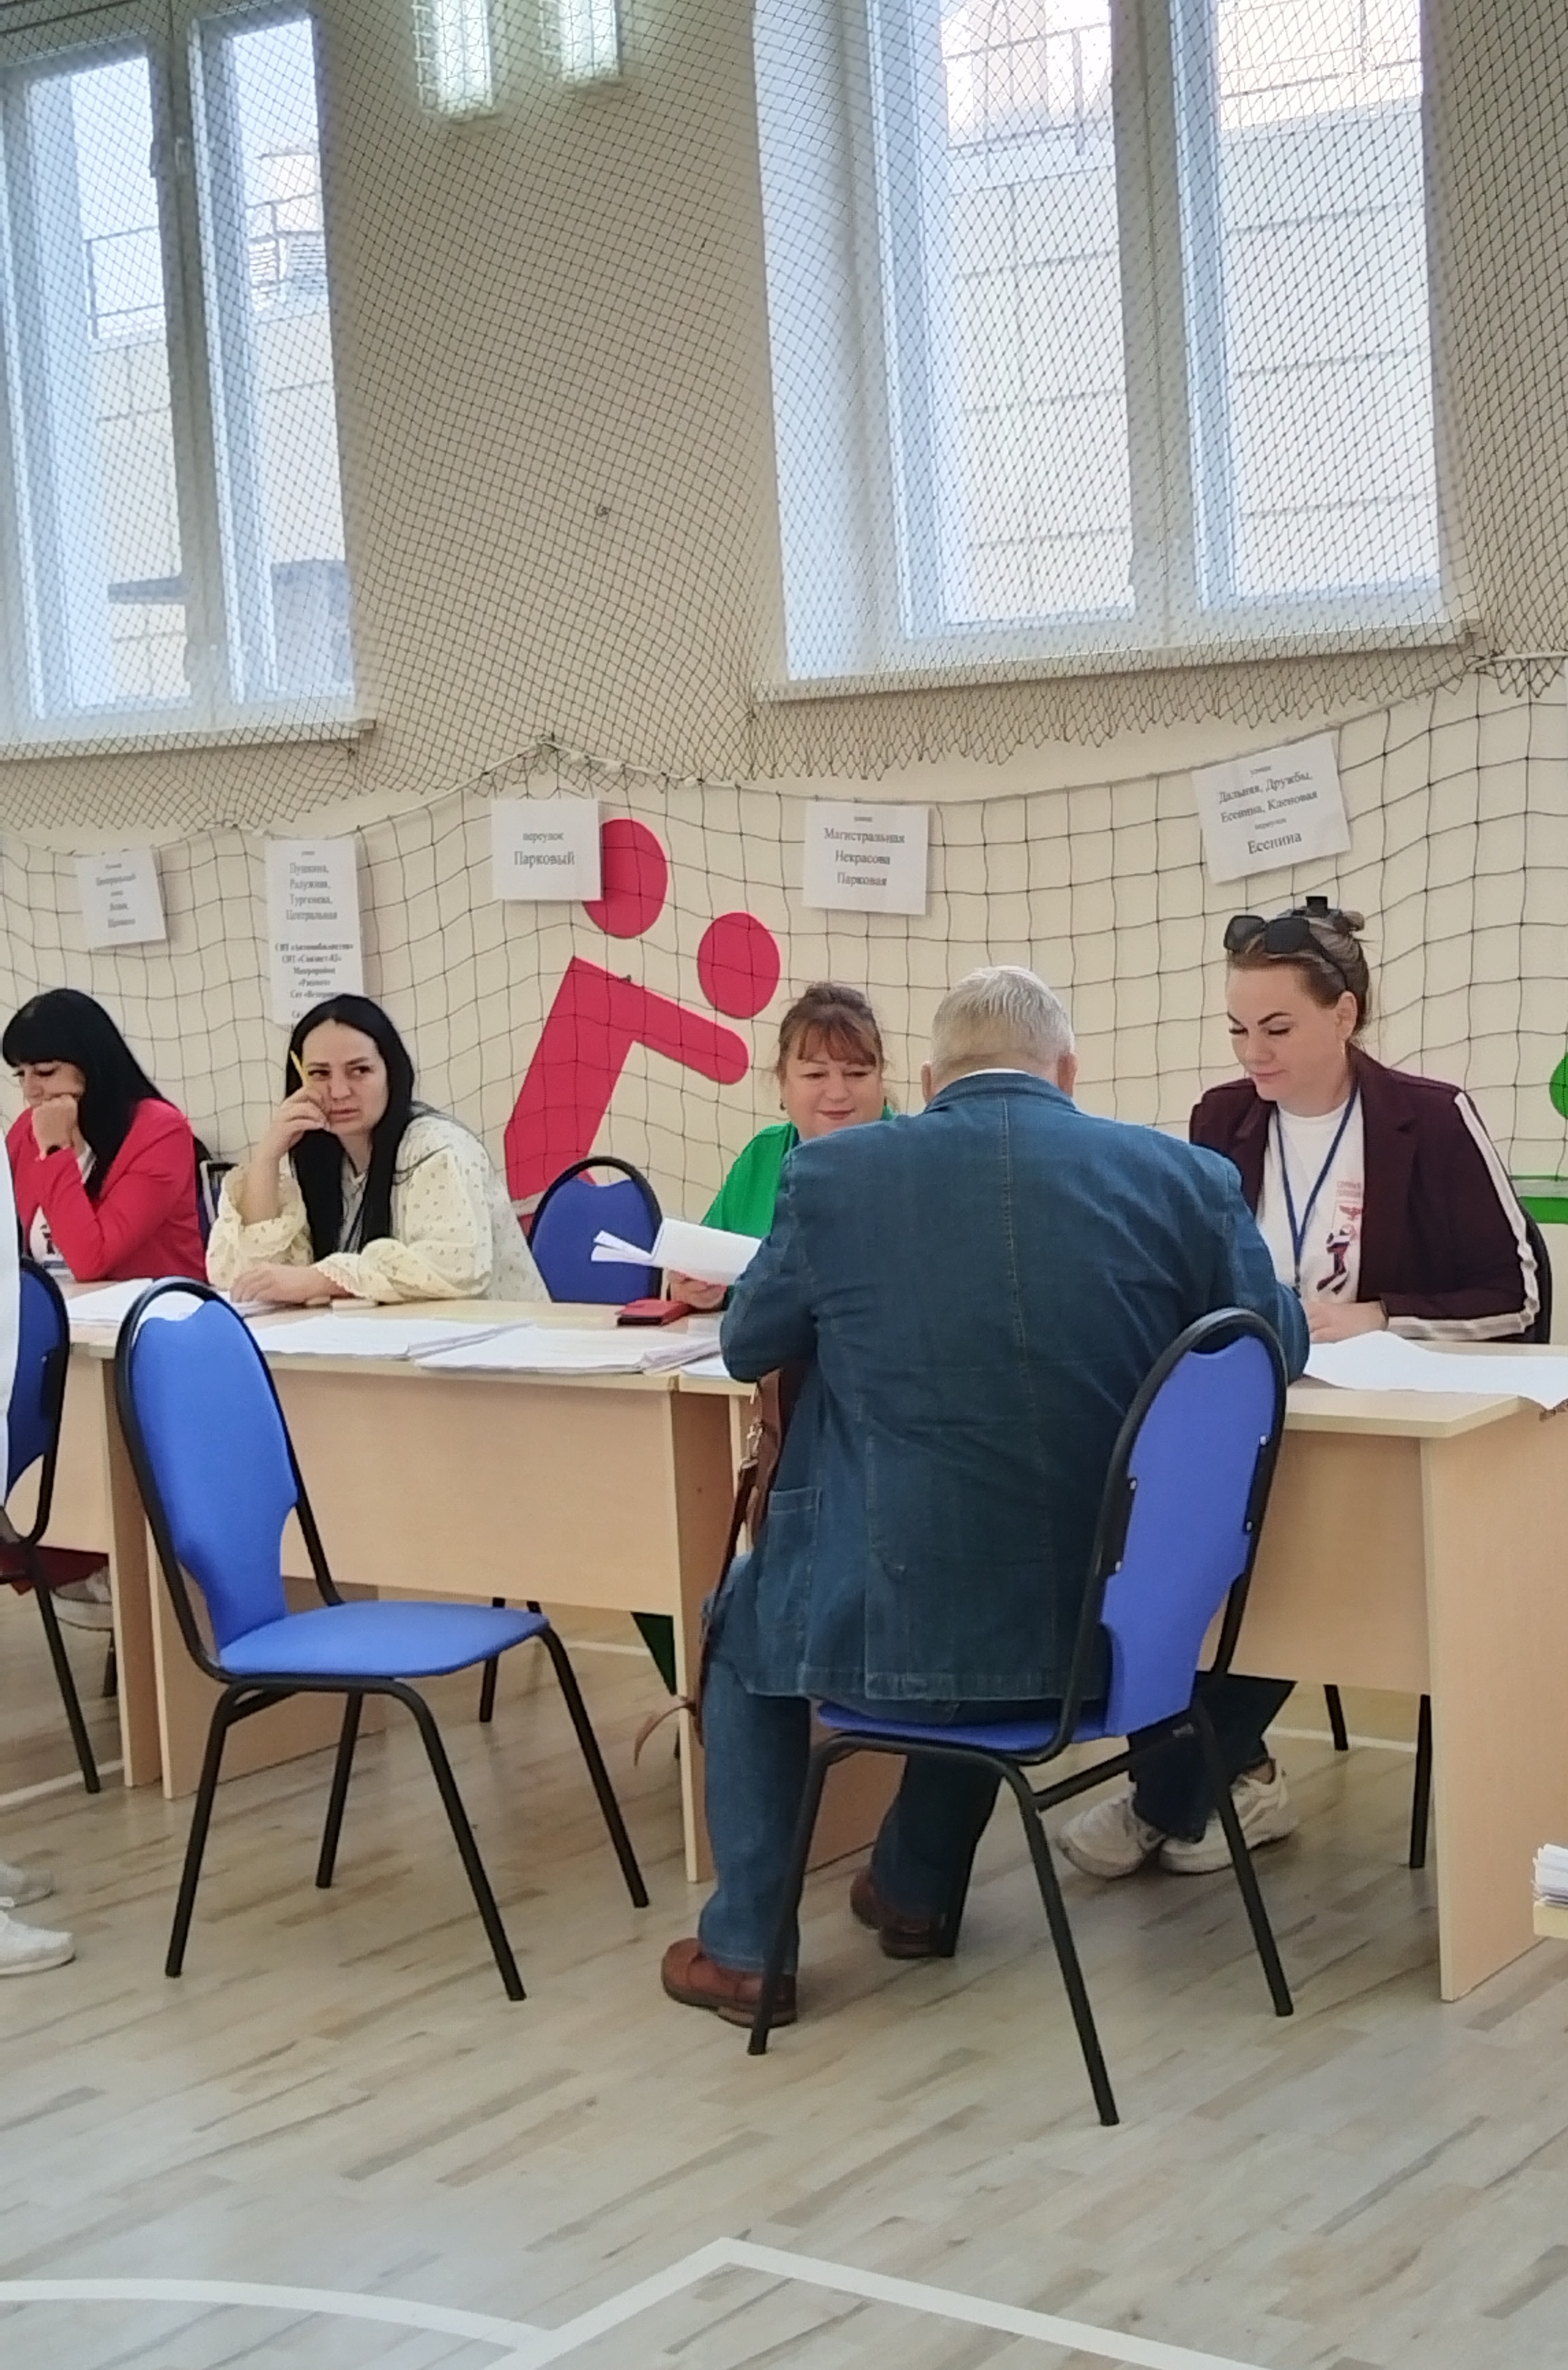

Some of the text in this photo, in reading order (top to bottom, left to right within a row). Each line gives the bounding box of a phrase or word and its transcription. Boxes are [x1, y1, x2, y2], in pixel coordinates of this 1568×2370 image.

[1219, 771, 1313, 804] Дальняя, Дружбы,
[1221, 806, 1266, 823] Есенина,
[522, 832, 564, 844] переулок
[824, 828, 905, 844] Магистральная
[1248, 833, 1302, 854] Есенина
[514, 850, 575, 869] Парковый
[835, 850, 891, 866] Некрасова
[837, 872, 887, 887] Парковая
